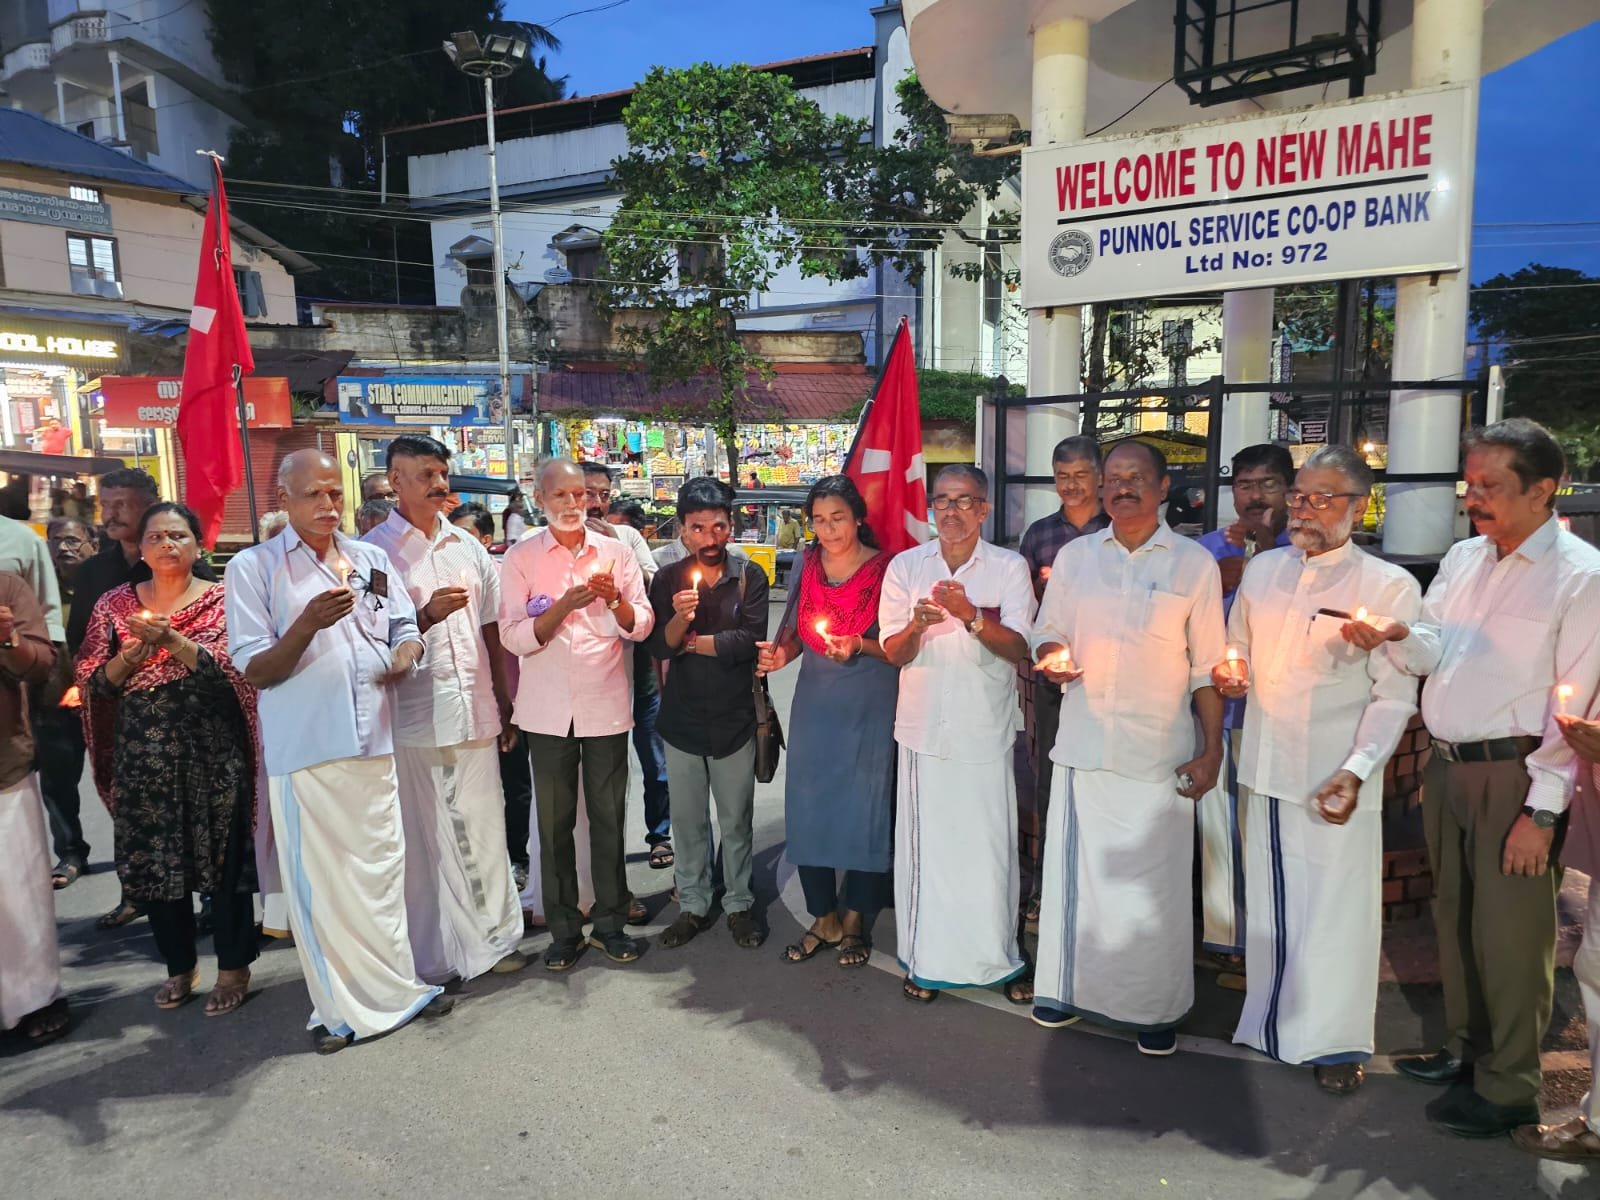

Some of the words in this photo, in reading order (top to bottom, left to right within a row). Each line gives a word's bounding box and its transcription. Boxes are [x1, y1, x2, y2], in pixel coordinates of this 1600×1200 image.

[1056, 148, 1196, 211] WELCOME
[1206, 140, 1245, 192] TO
[1256, 129, 1328, 188] NEW
[1336, 114, 1433, 177] MAHE
[1100, 220, 1182, 257] PUNNOL
[1189, 208, 1280, 247] SERVICE
[1287, 200, 1357, 236] CO-OP
[1364, 190, 1431, 229] BANK
[1185, 252, 1223, 274] Ltd
[1233, 249, 1273, 270] No:
[1281, 242, 1328, 265] 972
[46, 336, 118, 358] HOUSE
[367, 384, 393, 405] STAR
[394, 384, 475, 406] COMMUNICATION
[477, 435, 505, 443] SERVI
